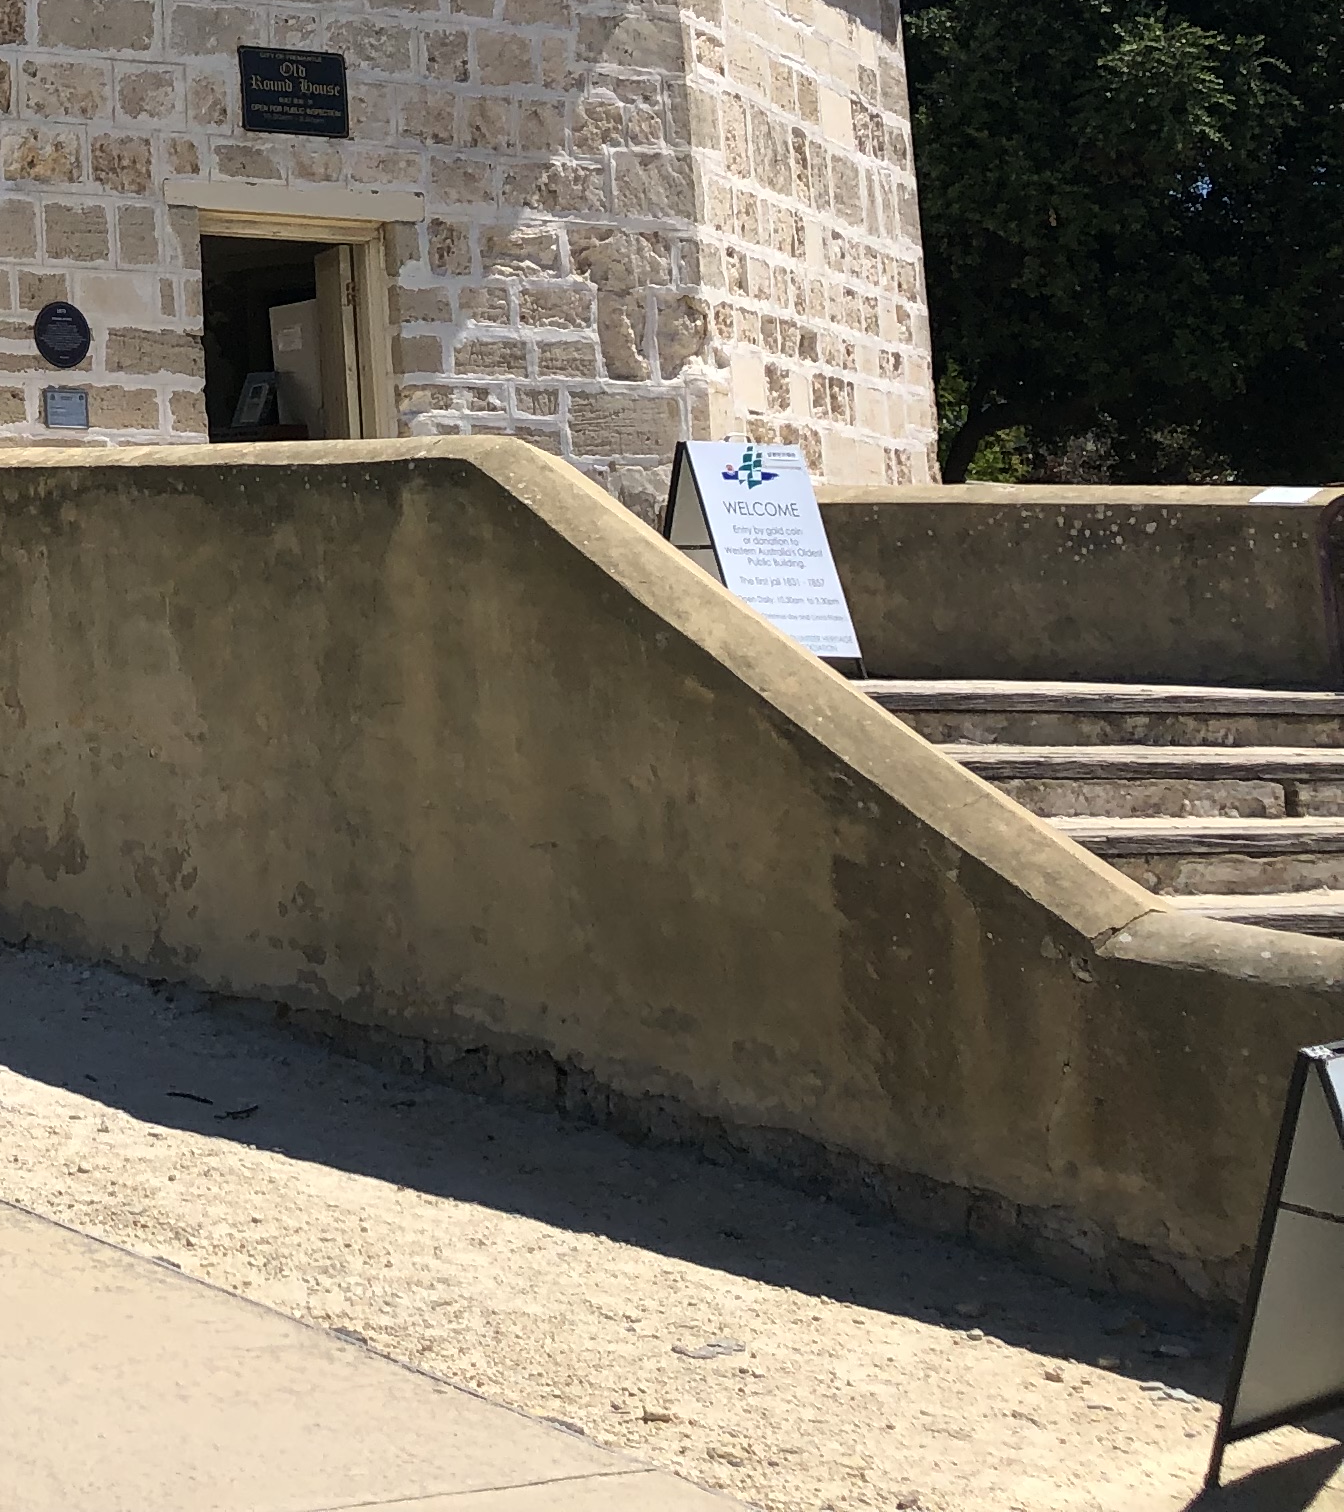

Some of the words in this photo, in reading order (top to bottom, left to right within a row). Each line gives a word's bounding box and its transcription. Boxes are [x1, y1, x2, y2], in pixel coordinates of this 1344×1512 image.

[279, 61, 306, 78] Old
[249, 74, 293, 92] Round
[298, 78, 341, 96] House
[251, 103, 269, 112] OPEN
[269, 104, 282, 113] FOR
[283, 105, 305, 115] PUBLIC
[722, 500, 801, 518] WELCOME
[732, 524, 752, 535] Entry
[752, 525, 764, 536] by
[765, 526, 784, 536] gold
[785, 527, 803, 536] coin
[742, 537, 751, 545] or
[752, 536, 789, 546] donation
[789, 538, 799, 546] to
[724, 547, 756, 555] Western
[758, 547, 796, 557] Australia's
[797, 548, 823, 557] Oldest
[747, 557, 772, 567] Public
[739, 576, 754, 585] The
[755, 577, 769, 586] first
[770, 577, 781, 587] jail
